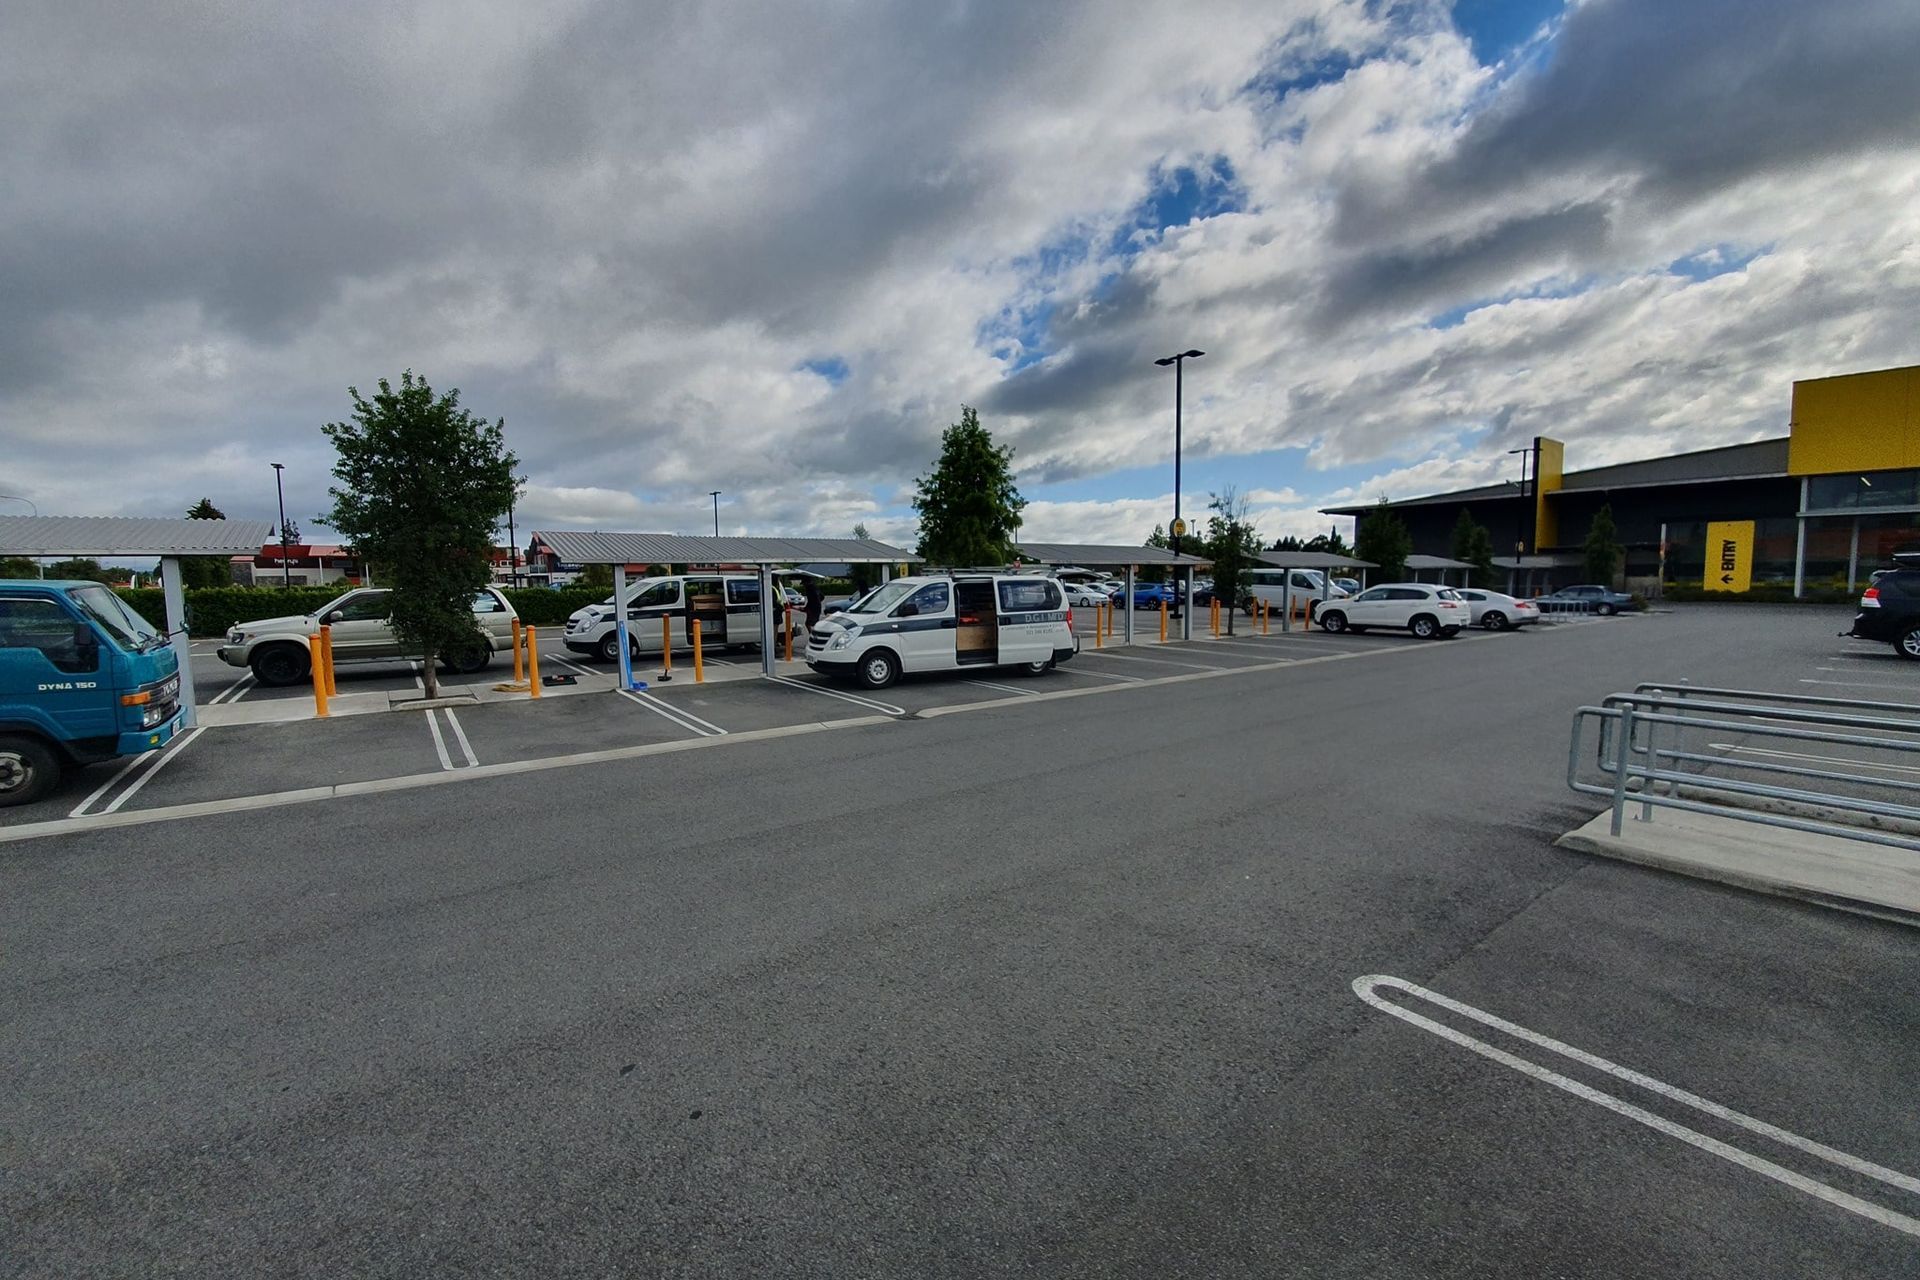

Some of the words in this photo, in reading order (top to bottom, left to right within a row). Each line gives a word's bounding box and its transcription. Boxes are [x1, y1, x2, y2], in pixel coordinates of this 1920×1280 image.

[1721, 539, 1736, 571] ENTRY
[38, 682, 73, 691] DYNA
[75, 681, 97, 689] 150
